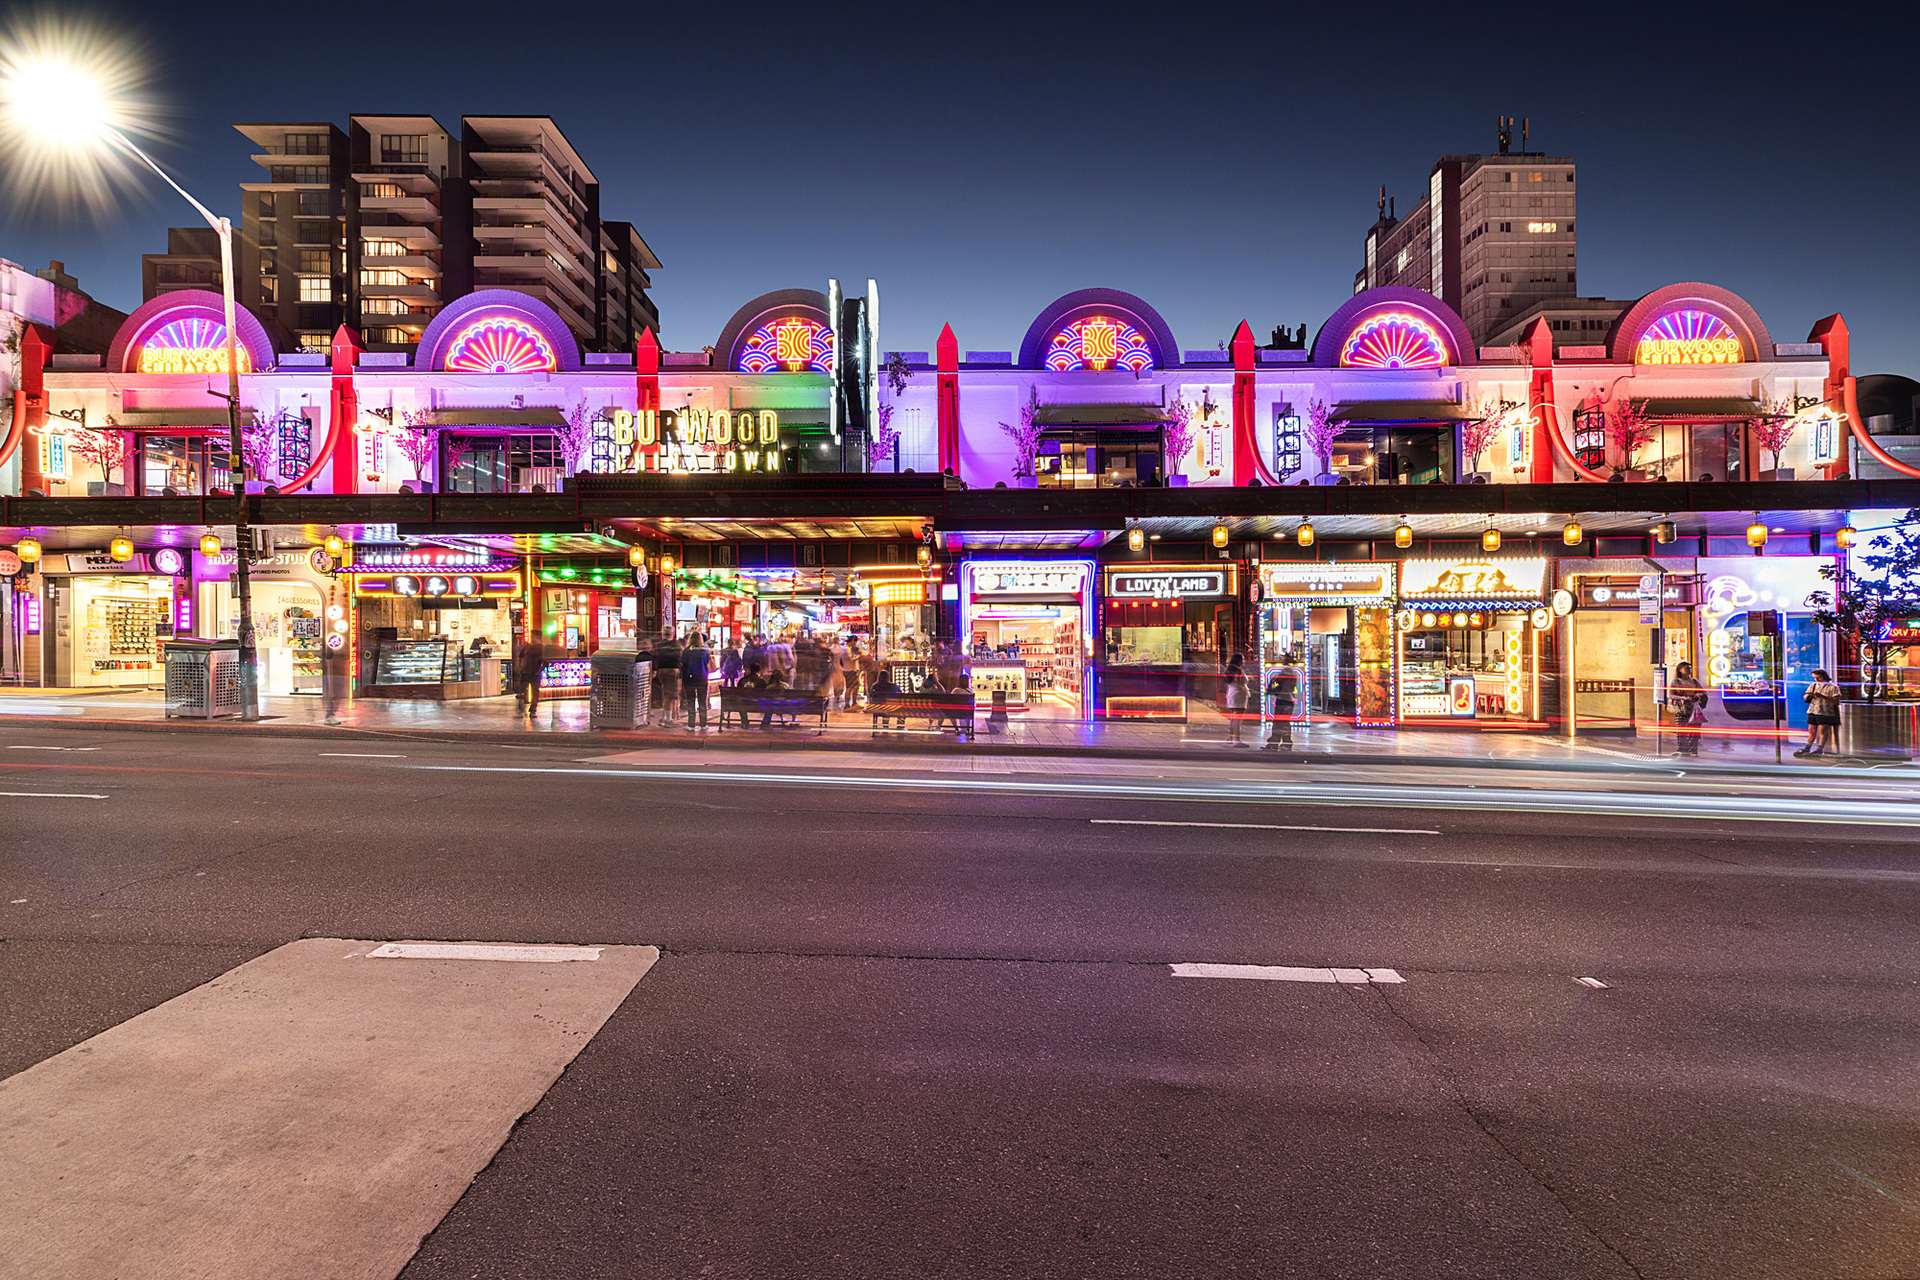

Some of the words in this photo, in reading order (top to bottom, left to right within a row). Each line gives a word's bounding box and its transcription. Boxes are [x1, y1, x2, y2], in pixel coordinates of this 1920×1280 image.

[1641, 339, 1740, 355] BURWOOD
[1641, 353, 1738, 364] CHINATOWN
[614, 409, 778, 445] BURWOOD
[616, 451, 779, 471] CHINATOWN
[208, 553, 239, 565] HAPP
[364, 554, 431, 565] HARVEST
[436, 554, 489, 565] FOODIE
